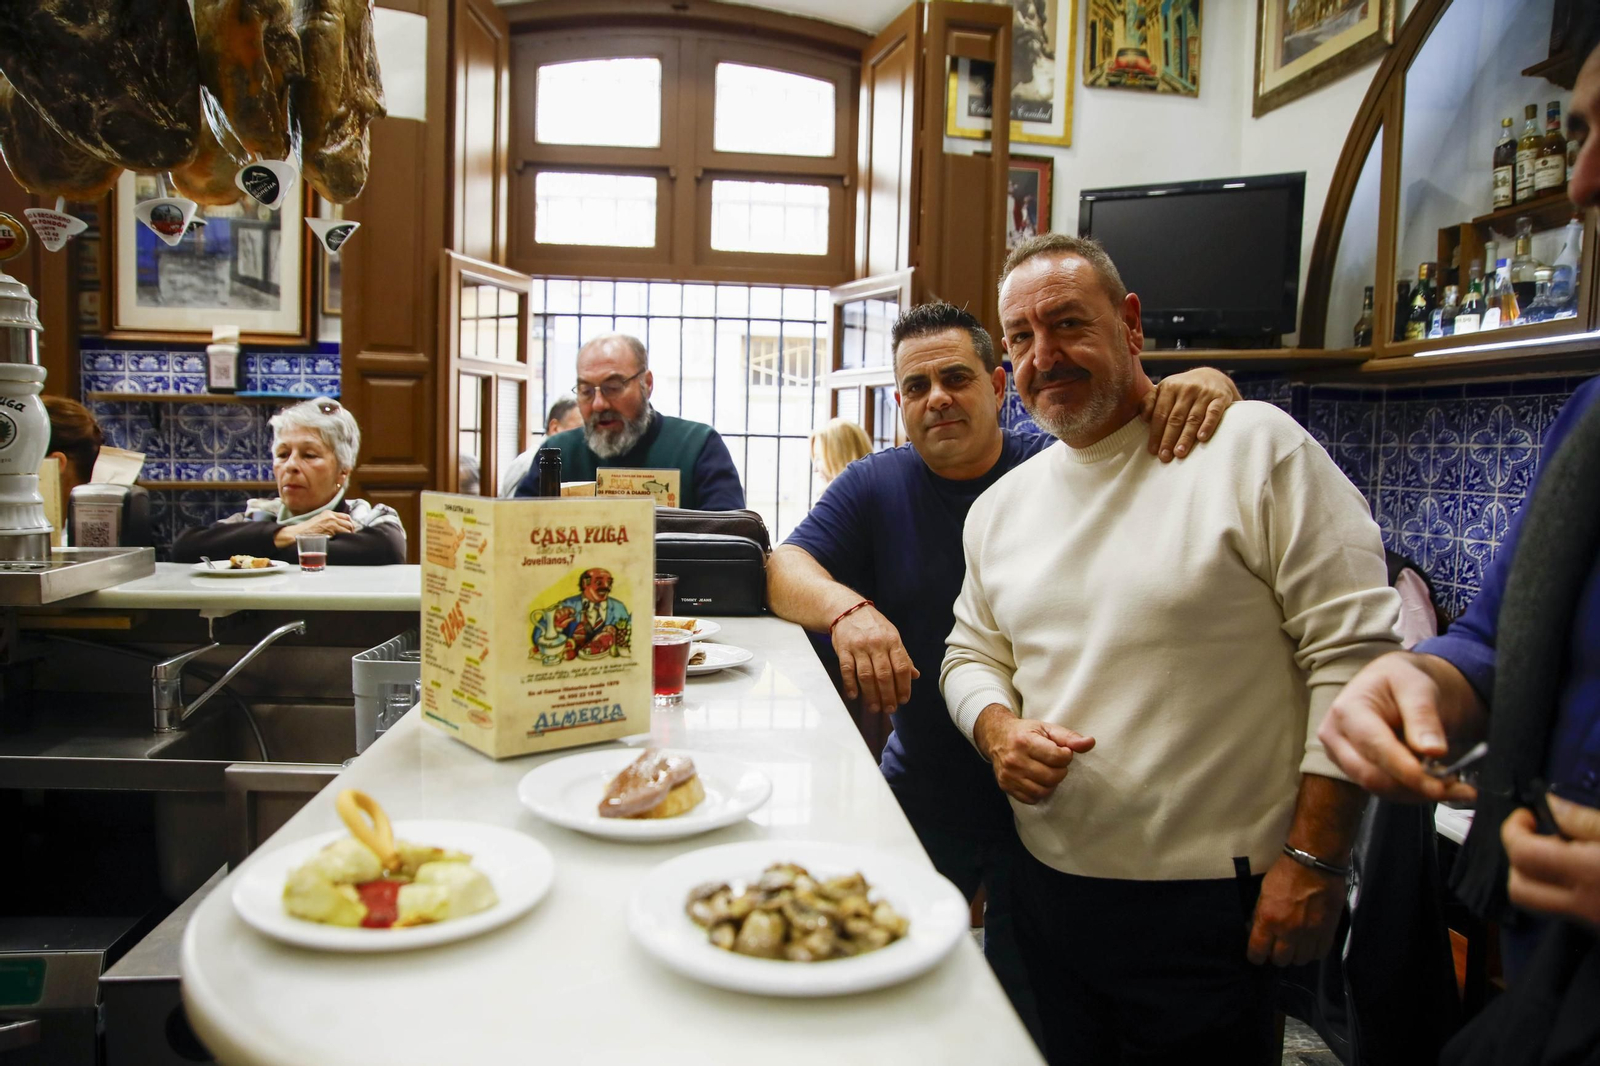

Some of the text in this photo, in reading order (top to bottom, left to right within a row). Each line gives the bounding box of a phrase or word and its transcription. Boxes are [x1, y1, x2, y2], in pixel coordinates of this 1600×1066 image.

[1017, 104, 1052, 119] Caridad
[530, 526, 580, 547] CASA
[532, 703, 624, 732] ALMERIA
